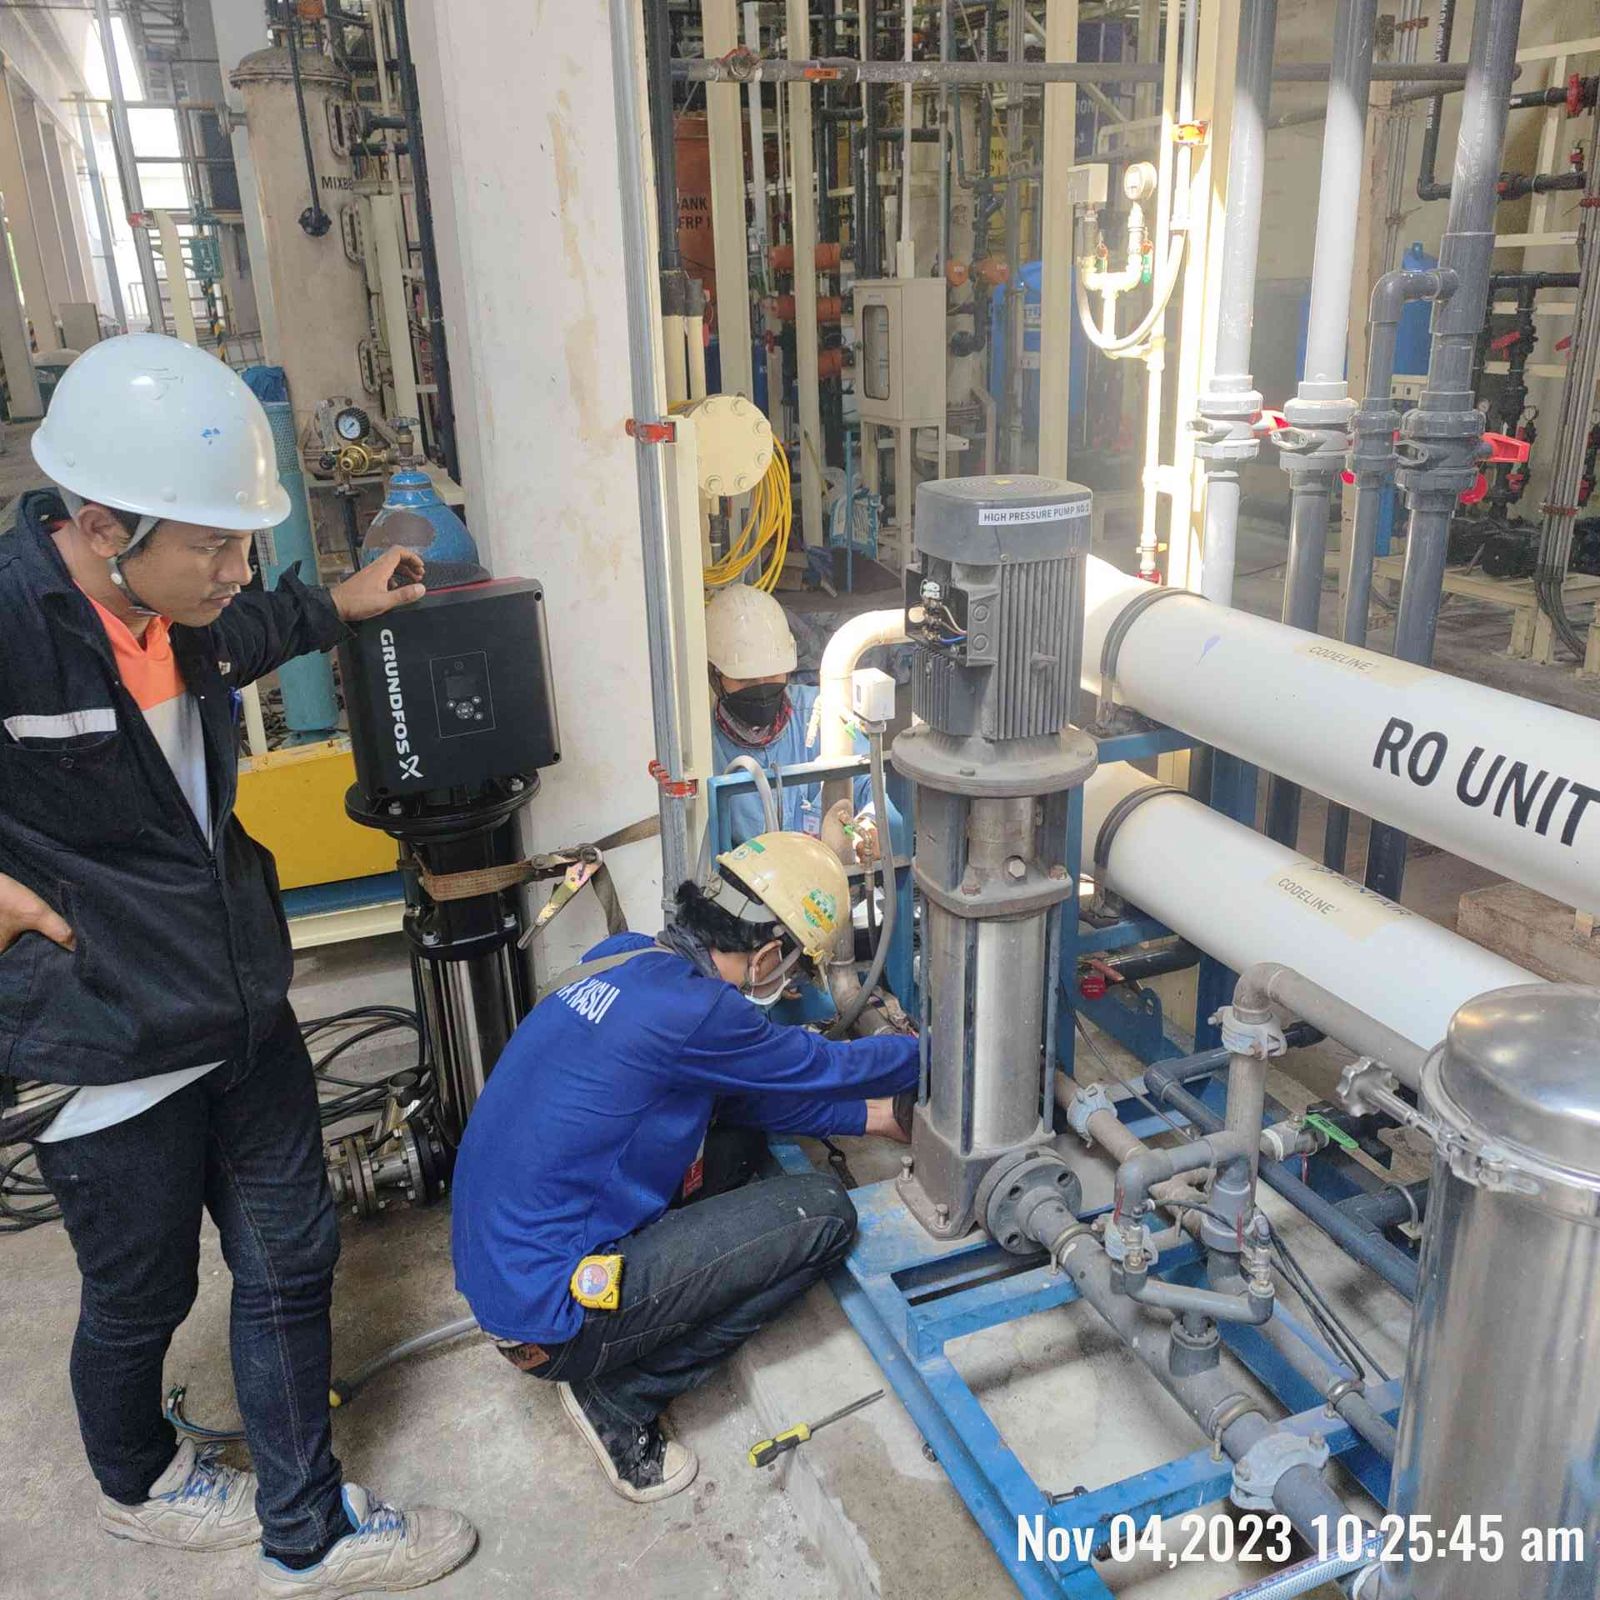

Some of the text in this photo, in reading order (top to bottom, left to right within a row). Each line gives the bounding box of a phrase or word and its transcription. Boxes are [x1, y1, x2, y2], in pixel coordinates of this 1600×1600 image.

[680, 197, 707, 210] ANK
[984, 512, 1007, 522] HIGH
[1009, 509, 1052, 521] PRESSURE
[1053, 505, 1075, 518] PUMP
[1309, 646, 1373, 671] CODELINE
[380, 628, 410, 755] GRUNDFOS
[1372, 716, 1600, 847] RO UNIT
[1278, 877, 1335, 915] CODELINE
